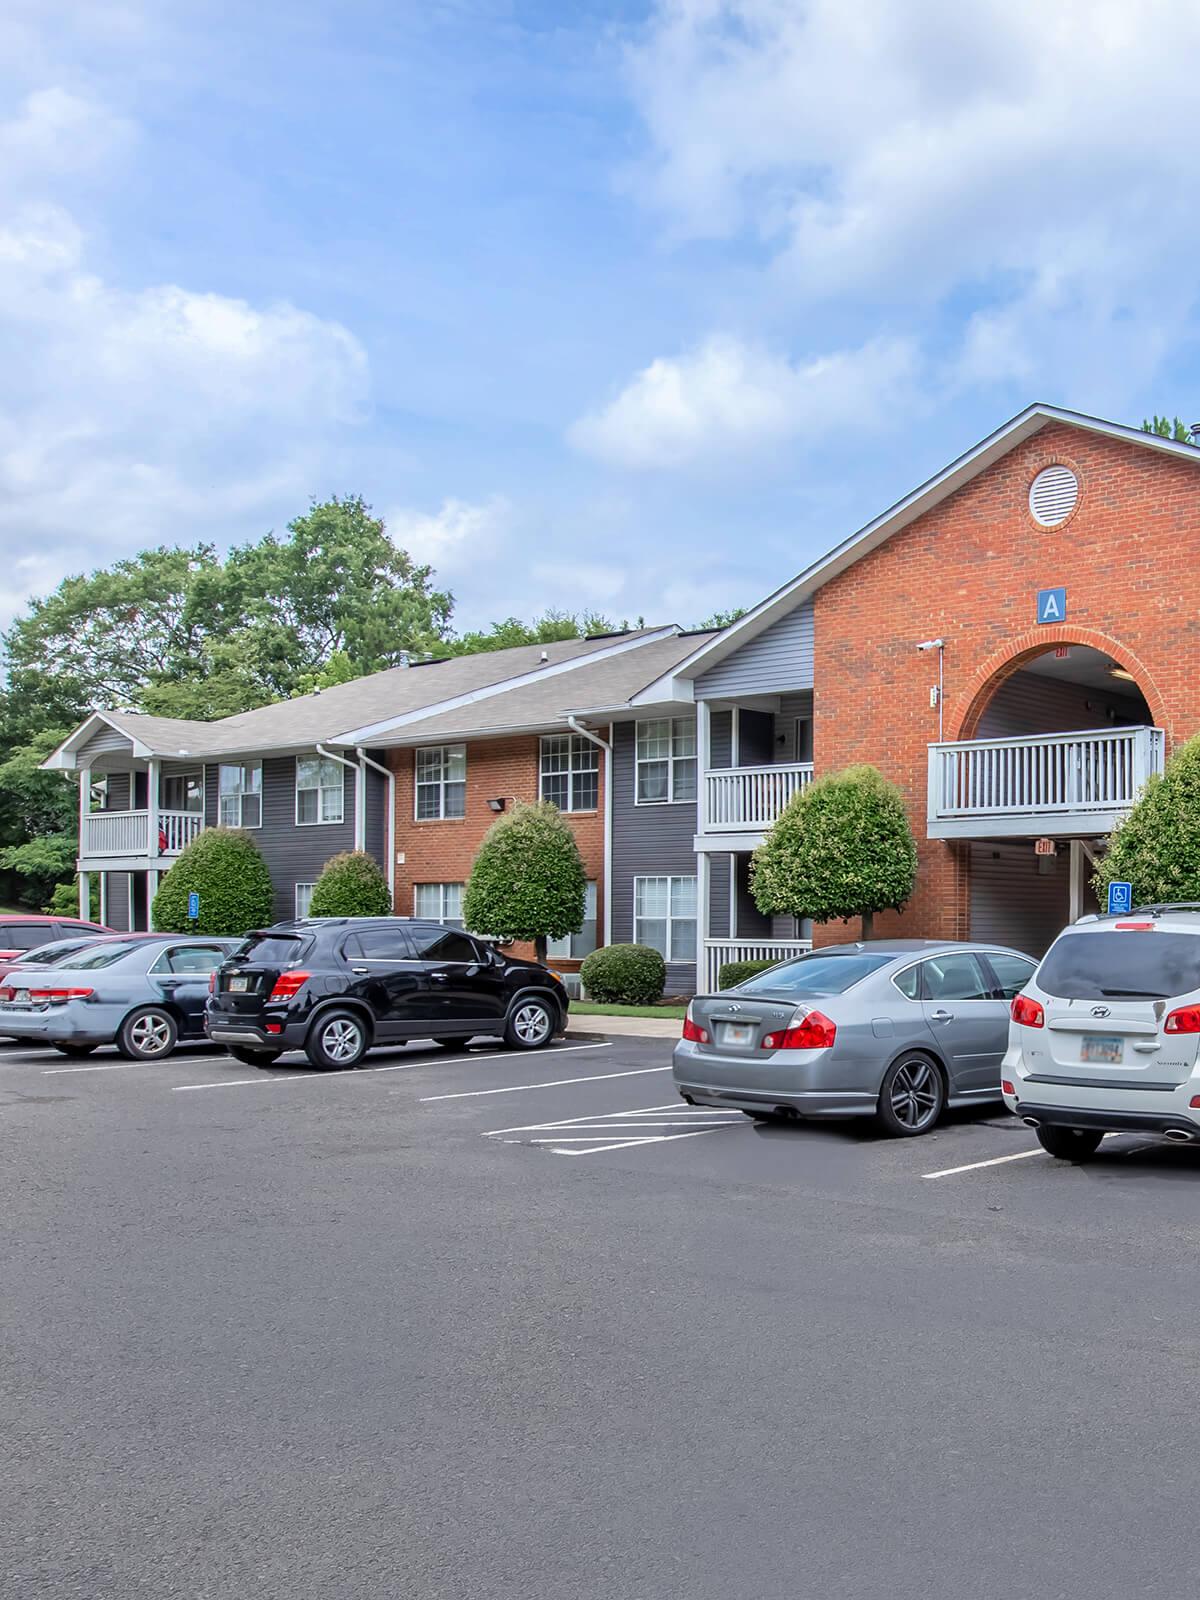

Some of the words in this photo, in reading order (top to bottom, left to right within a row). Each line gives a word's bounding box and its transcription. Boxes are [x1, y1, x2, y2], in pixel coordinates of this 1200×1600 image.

[1043, 594, 1060, 618] A
[1056, 647, 1068, 658] EXIT
[1039, 841, 1051, 853] EXIT
